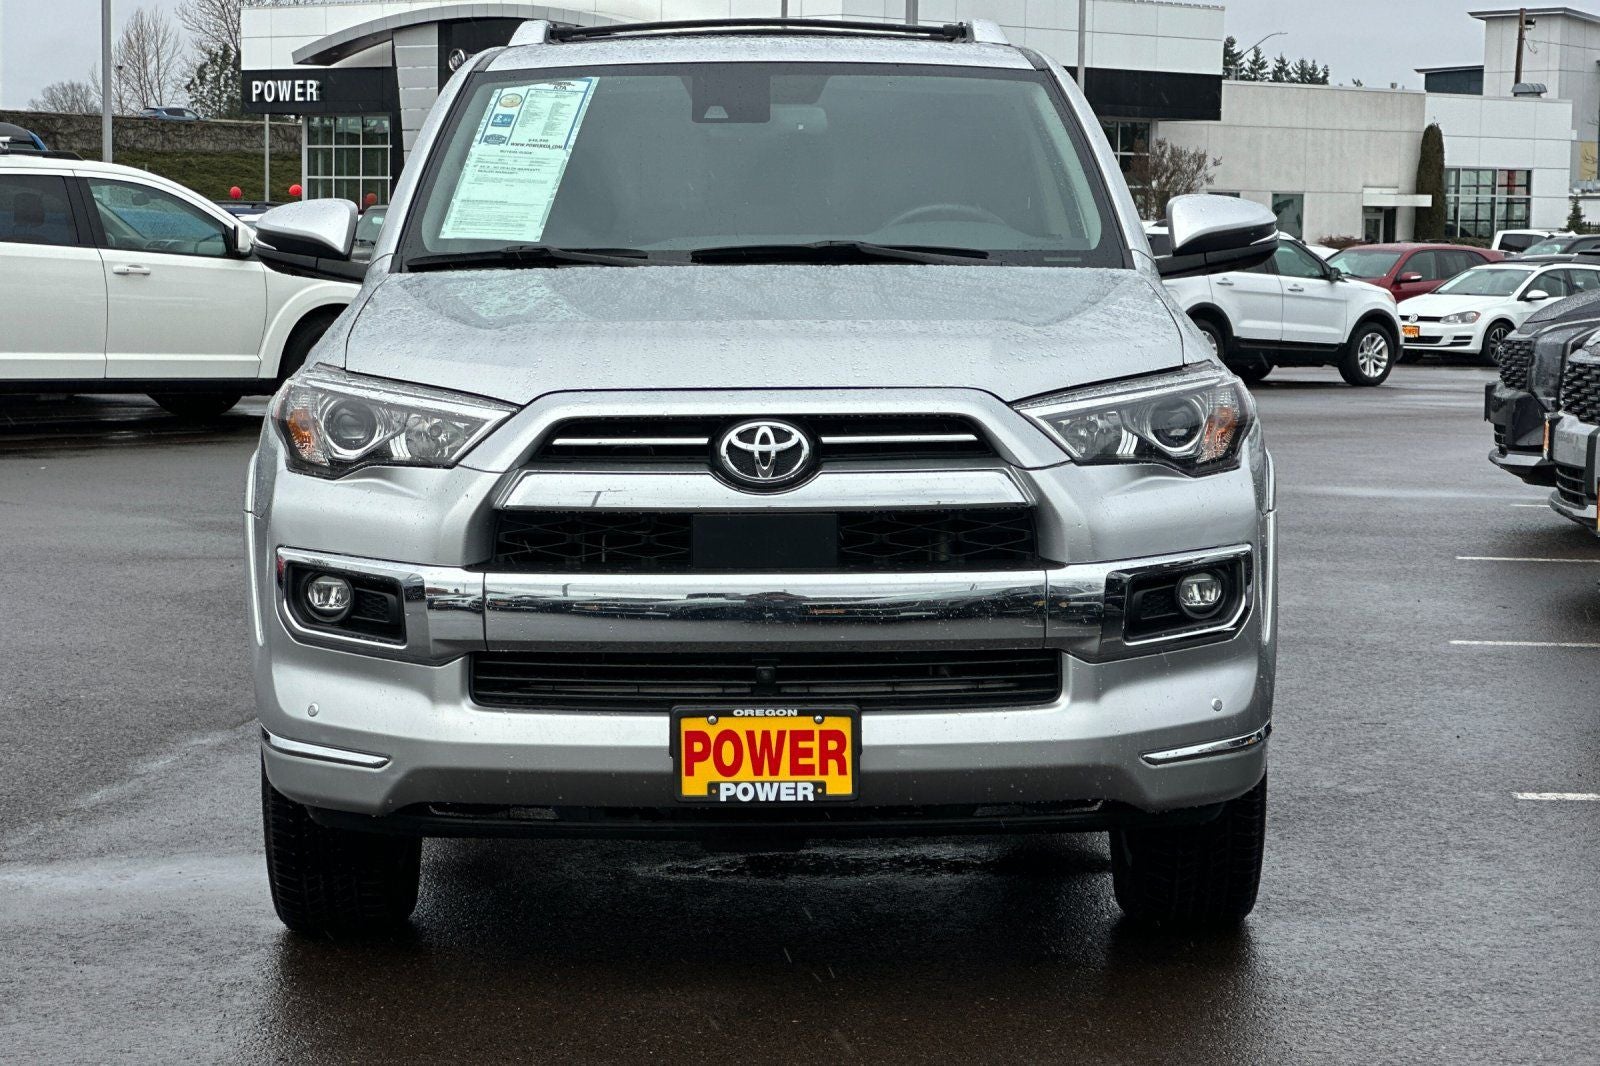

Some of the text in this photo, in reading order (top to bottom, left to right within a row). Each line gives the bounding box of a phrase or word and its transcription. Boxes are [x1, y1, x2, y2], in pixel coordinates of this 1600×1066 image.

[252, 80, 320, 102] POWER
[733, 709, 798, 717] OREGON
[684, 729, 848, 777] POWER
[719, 782, 815, 802] POWER
